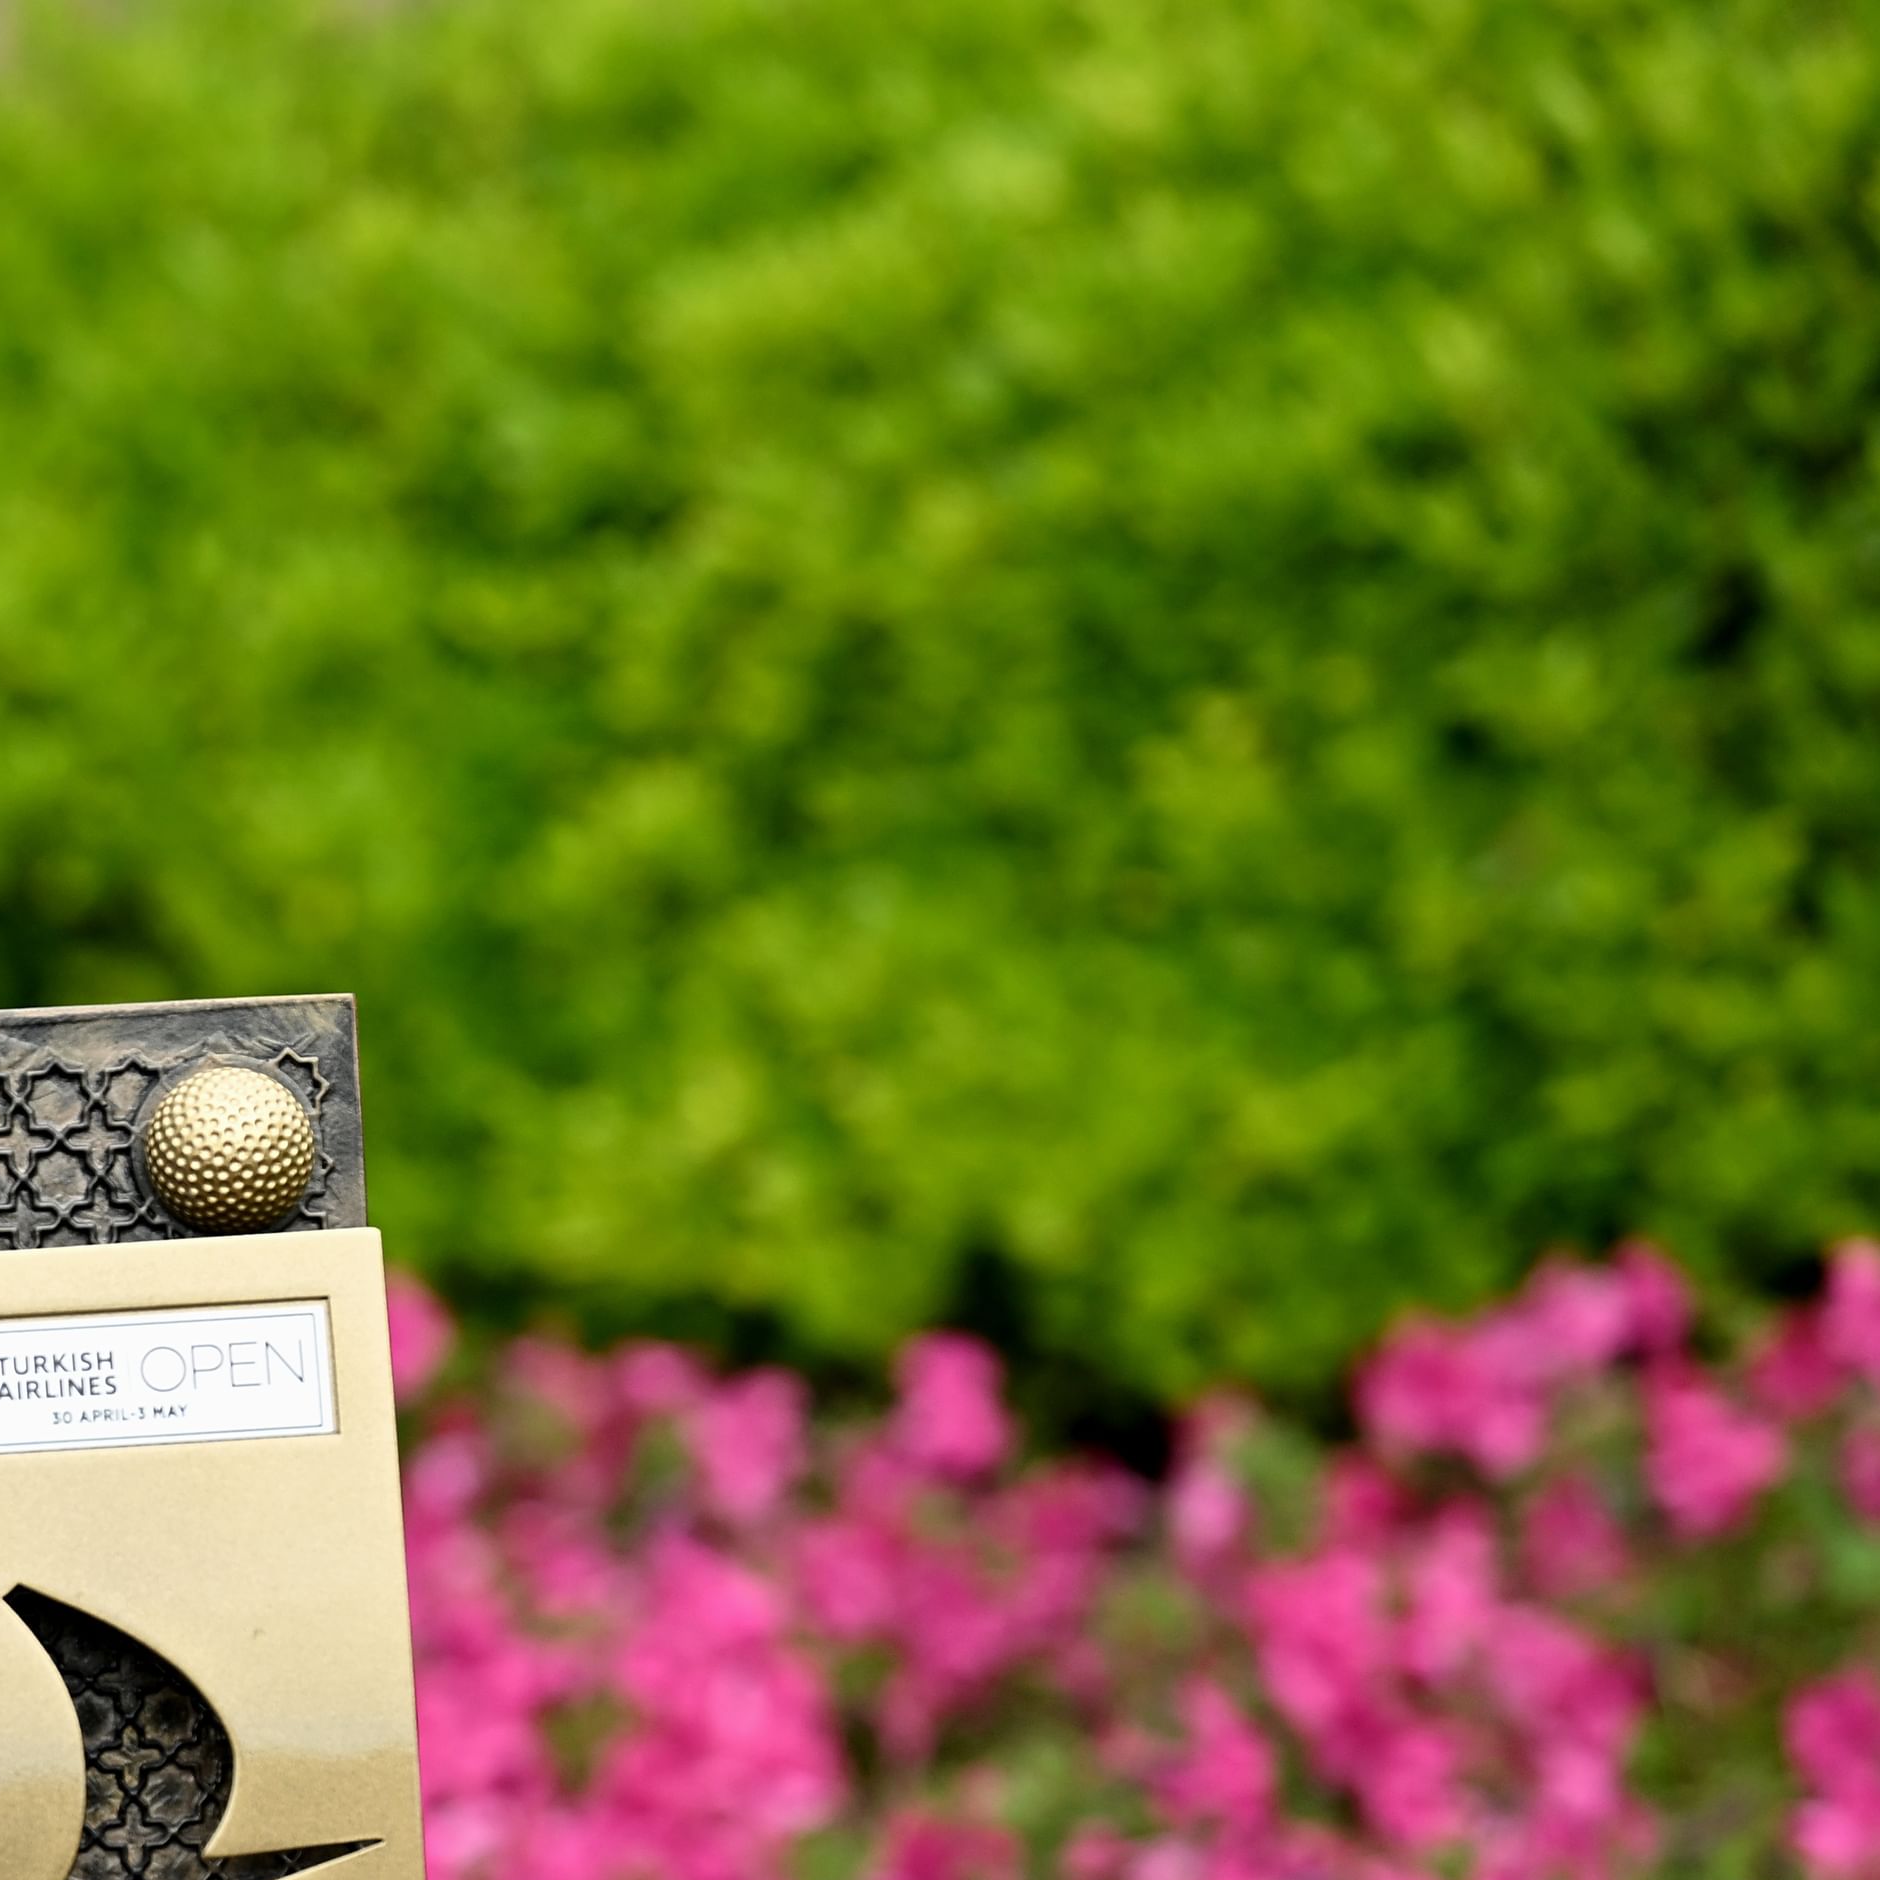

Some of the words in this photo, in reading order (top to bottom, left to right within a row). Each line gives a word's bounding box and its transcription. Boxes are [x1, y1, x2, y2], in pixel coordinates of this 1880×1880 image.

[140, 1339, 305, 1393] OPEN
[52, 1411, 73, 1425] 30
[152, 1404, 189, 1419] MAY
